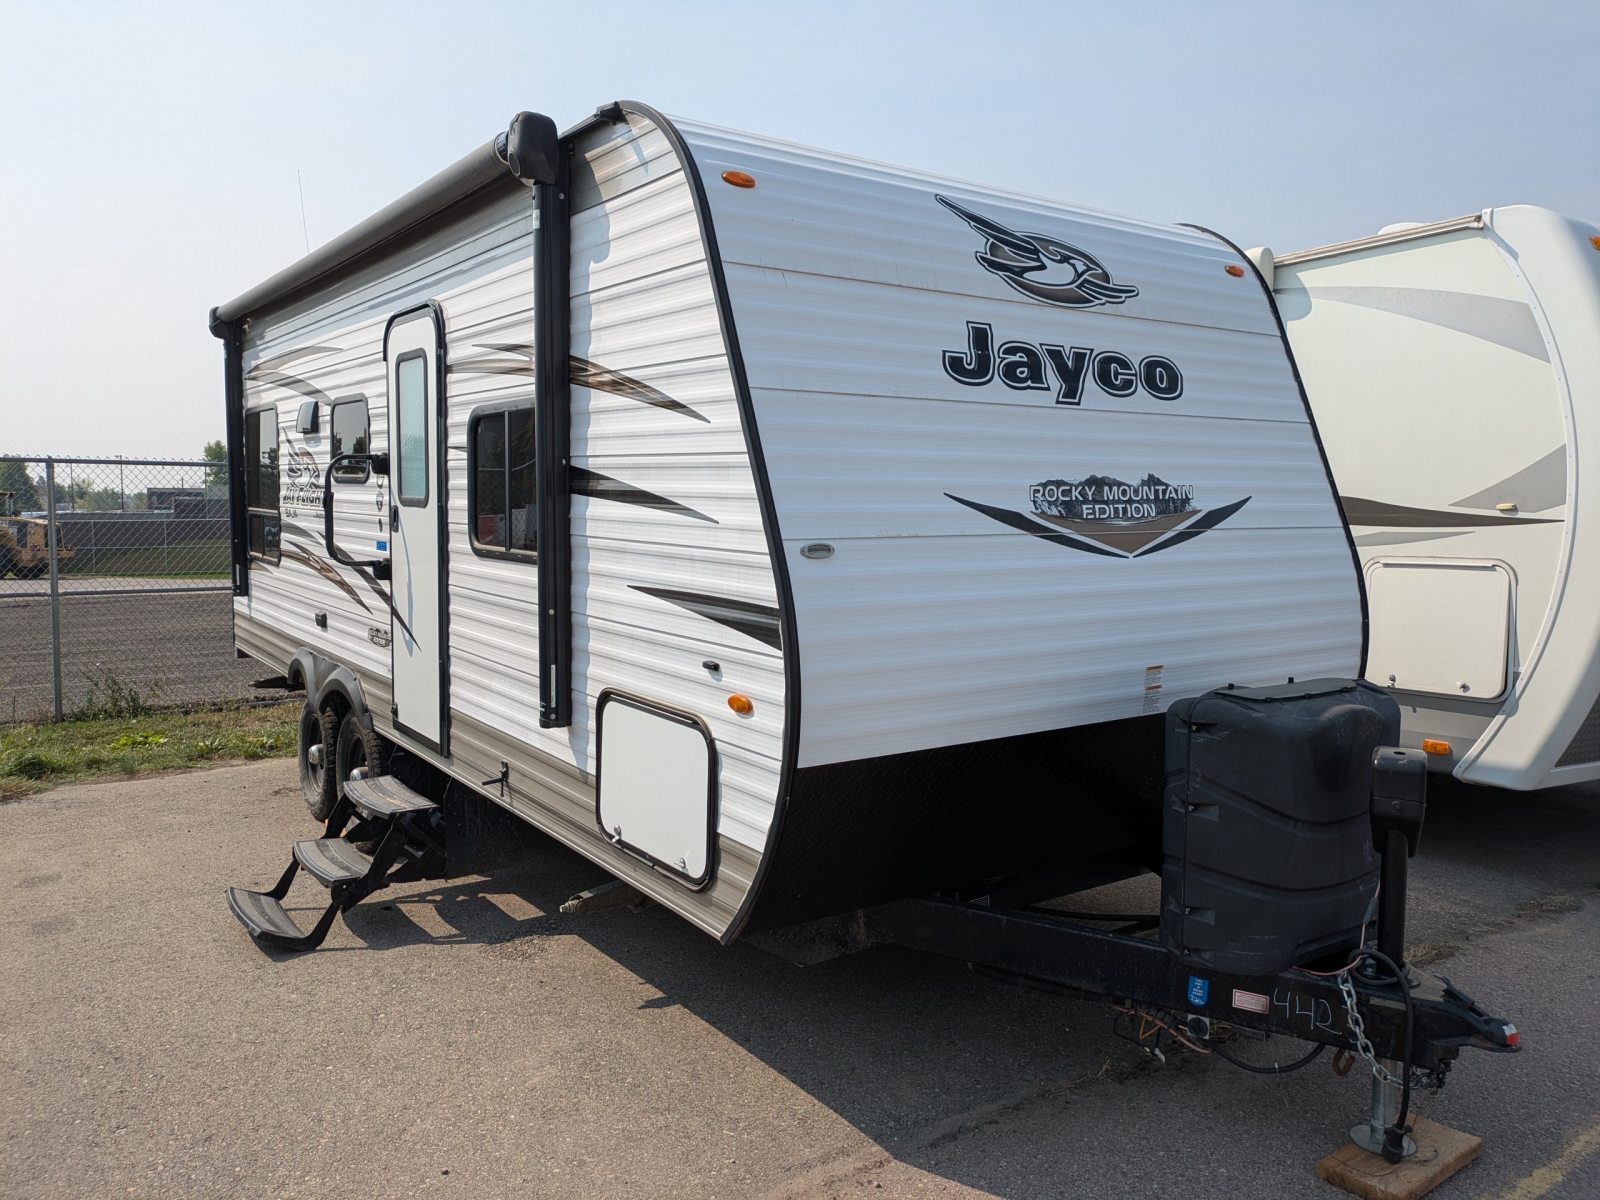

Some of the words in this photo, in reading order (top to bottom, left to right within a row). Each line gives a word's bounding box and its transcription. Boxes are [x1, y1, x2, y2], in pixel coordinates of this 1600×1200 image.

[942, 320, 1183, 406] Jayco
[1029, 484, 1097, 501] ROCKY
[1103, 484, 1194, 501] MOUNTAIN
[1082, 503, 1157, 519] EDITION
